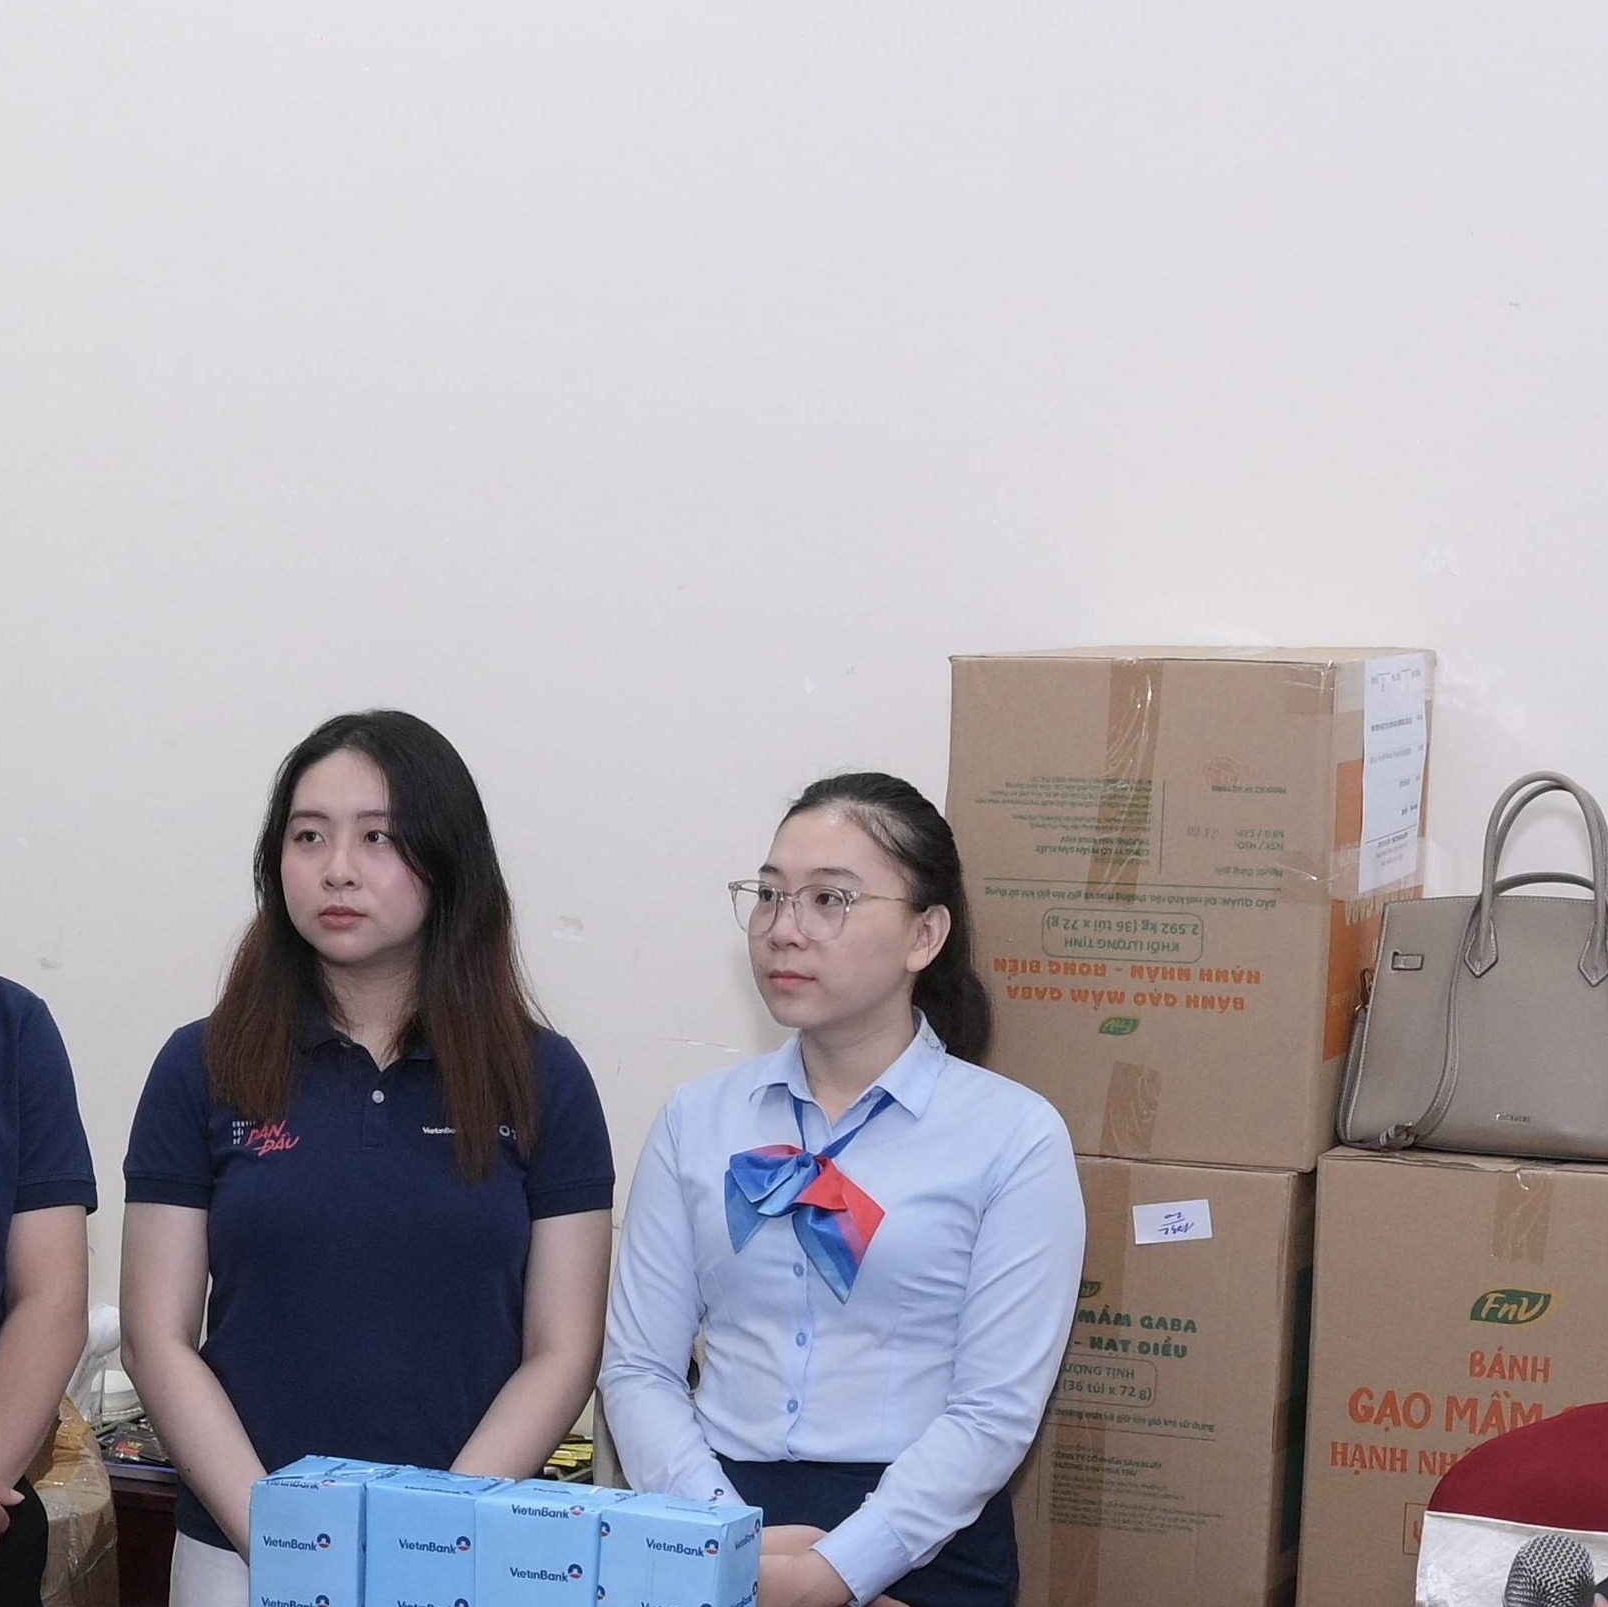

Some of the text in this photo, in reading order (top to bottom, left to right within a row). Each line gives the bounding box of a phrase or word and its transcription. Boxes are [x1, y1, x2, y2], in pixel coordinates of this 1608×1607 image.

[1061, 918, 1079, 931] 72
[1093, 918, 1113, 934] túi
[1114, 920, 1138, 935] (36
[1140, 919, 1158, 935] kg
[1161, 922, 1200, 936] 2.592
[1047, 960, 1107, 978] RONG
[1130, 963, 1192, 984] NHÂN
[1198, 964, 1261, 985] HẠNH
[1006, 984, 1063, 1001] GABA
[1133, 987, 1178, 1007] GẠO
[1185, 994, 1245, 1015] BÁNH
[1480, 1291, 1545, 1322] FnV
[1139, 1315, 1198, 1334] GABA
[1089, 1336, 1132, 1356] HẠT
[1105, 1366, 1136, 1380] TỊNH
[1468, 1346, 1551, 1384] BÁNH
[1119, 1384, 1136, 1398] 72
[1348, 1386, 1545, 1436] GẠO MẦM
[1329, 1441, 1409, 1476] HẠNH
[511, 1504, 570, 1519] VietinBank
[262, 1534, 318, 1553] VietinBank
[398, 1537, 458, 1555] VietinBank
[645, 1537, 705, 1557] VietinBank
[509, 1566, 569, 1583] VietinBank
